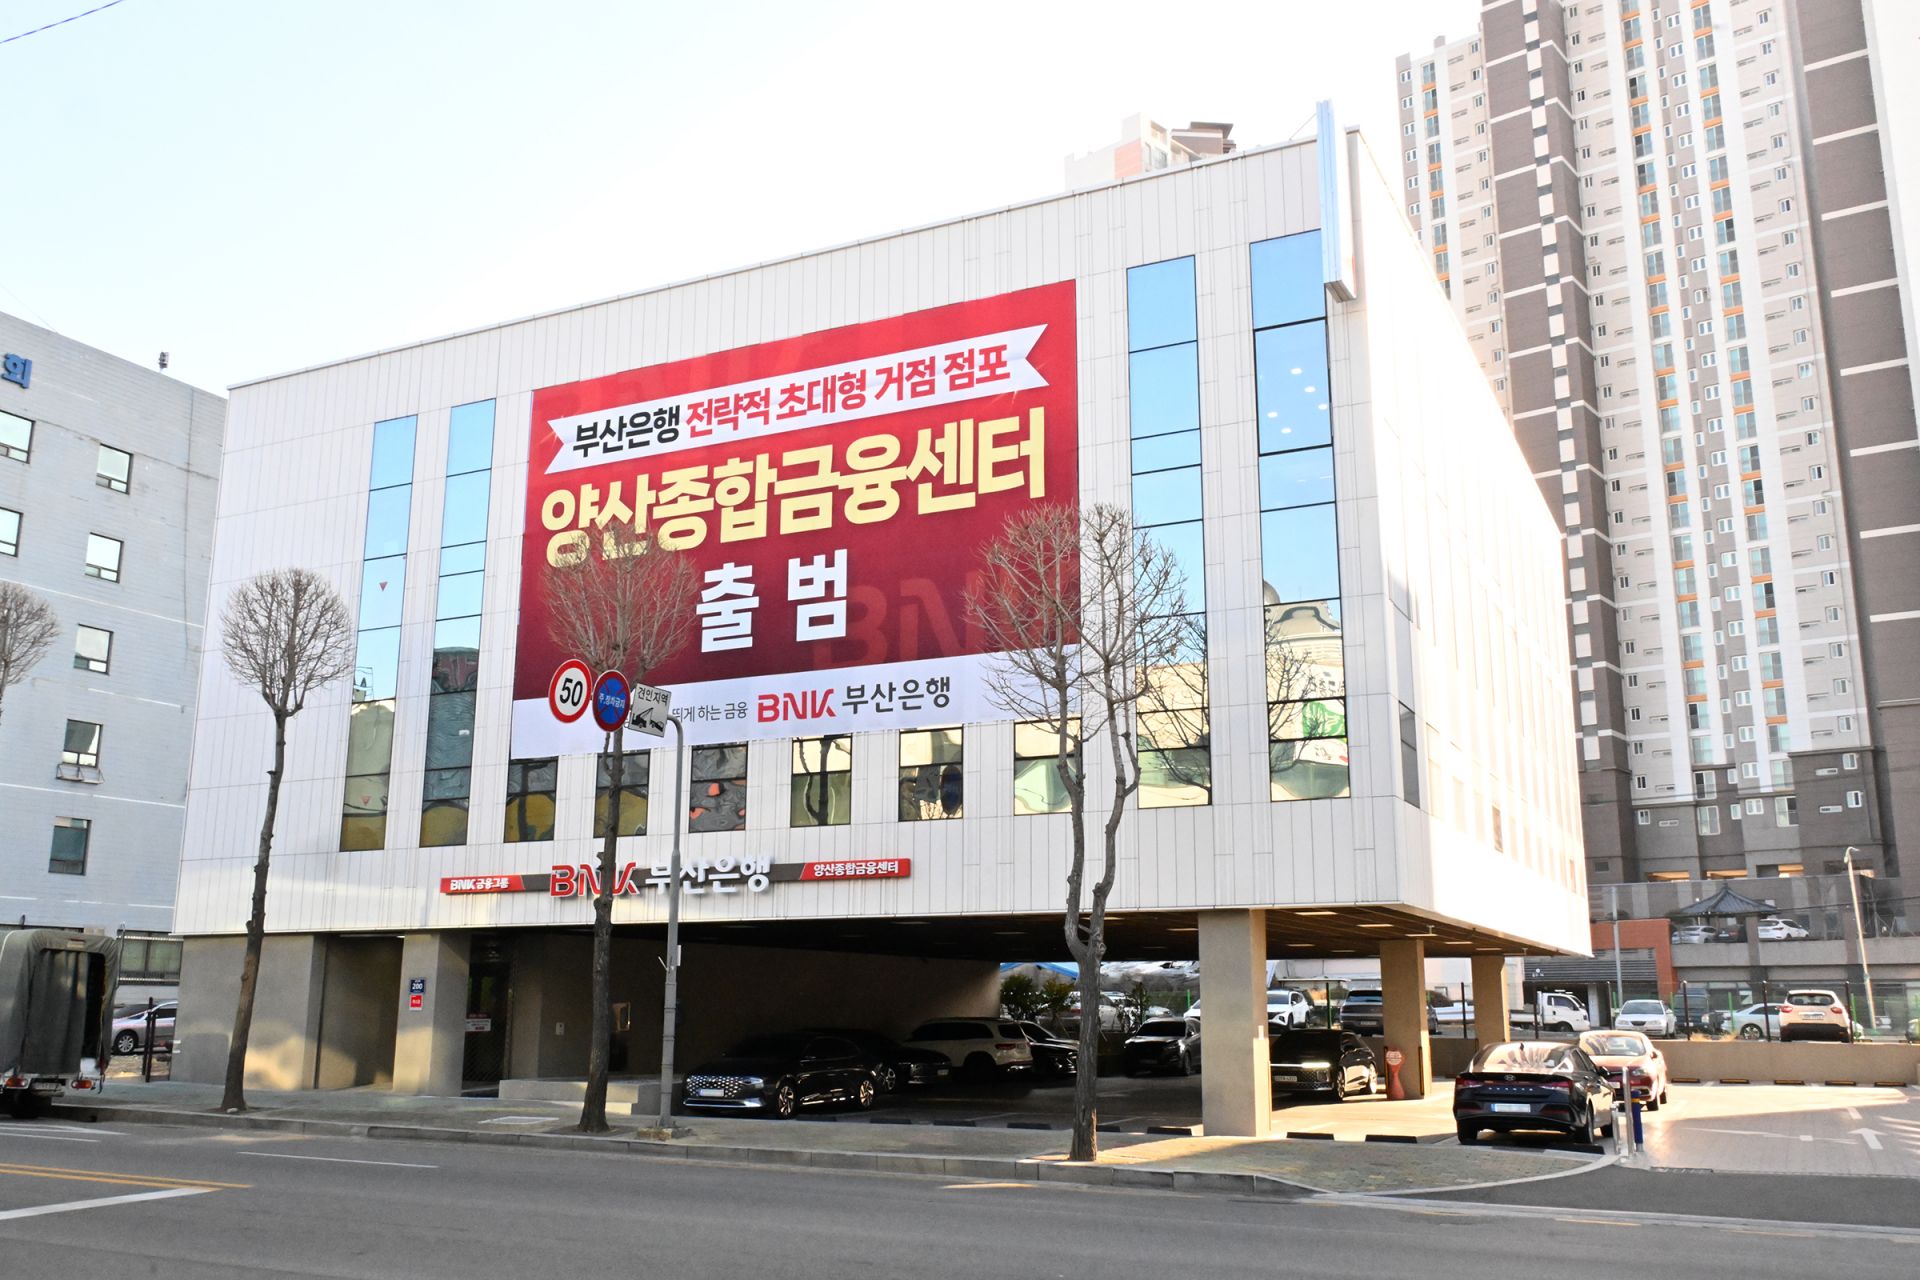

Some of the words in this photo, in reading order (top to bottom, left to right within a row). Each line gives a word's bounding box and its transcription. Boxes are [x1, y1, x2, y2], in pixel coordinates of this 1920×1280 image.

[573, 405, 681, 457] 부산은행
[686, 387, 771, 438] 전략적
[776, 369, 867, 421] 초대형
[874, 356, 936, 401] 거점
[943, 344, 1011, 391] 점포
[541, 406, 1045, 568] 양산종합금융센터
[559, 677, 584, 707] 50
[757, 688, 837, 723] BNK
[842, 676, 951, 714] 부산은행
[697, 704, 722, 721] 하는
[724, 701, 748, 720] 금융
[550, 862, 639, 897] BNK
[645, 855, 772, 895] 부산은행
[813, 860, 899, 877] 양산종합금융센터
